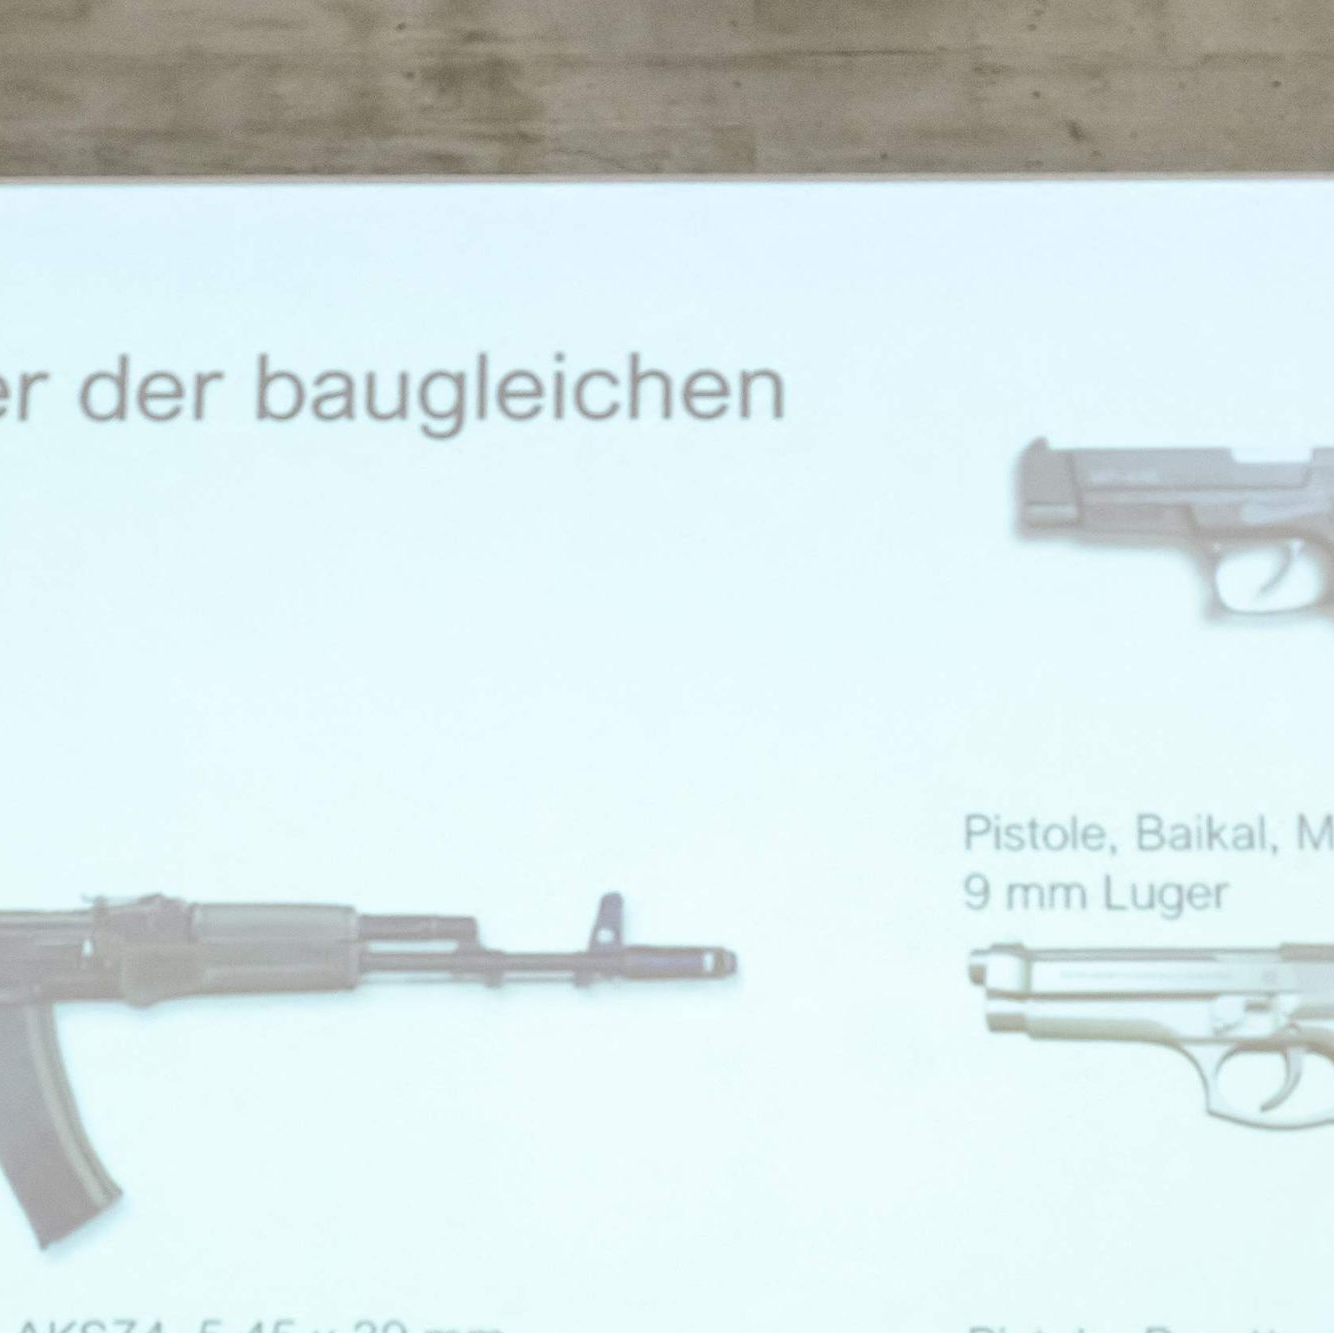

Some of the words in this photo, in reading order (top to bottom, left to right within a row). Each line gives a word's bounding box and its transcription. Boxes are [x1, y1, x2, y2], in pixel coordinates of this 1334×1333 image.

[78, 354, 224, 422] der
[255, 352, 785, 441] baugleichen
[964, 813, 1117, 856] Pistole,
[1136, 813, 1279, 856] Baikal,
[963, 872, 991, 911] 9
[1006, 882, 1087, 911] mm
[1103, 873, 1230, 921] Luger
